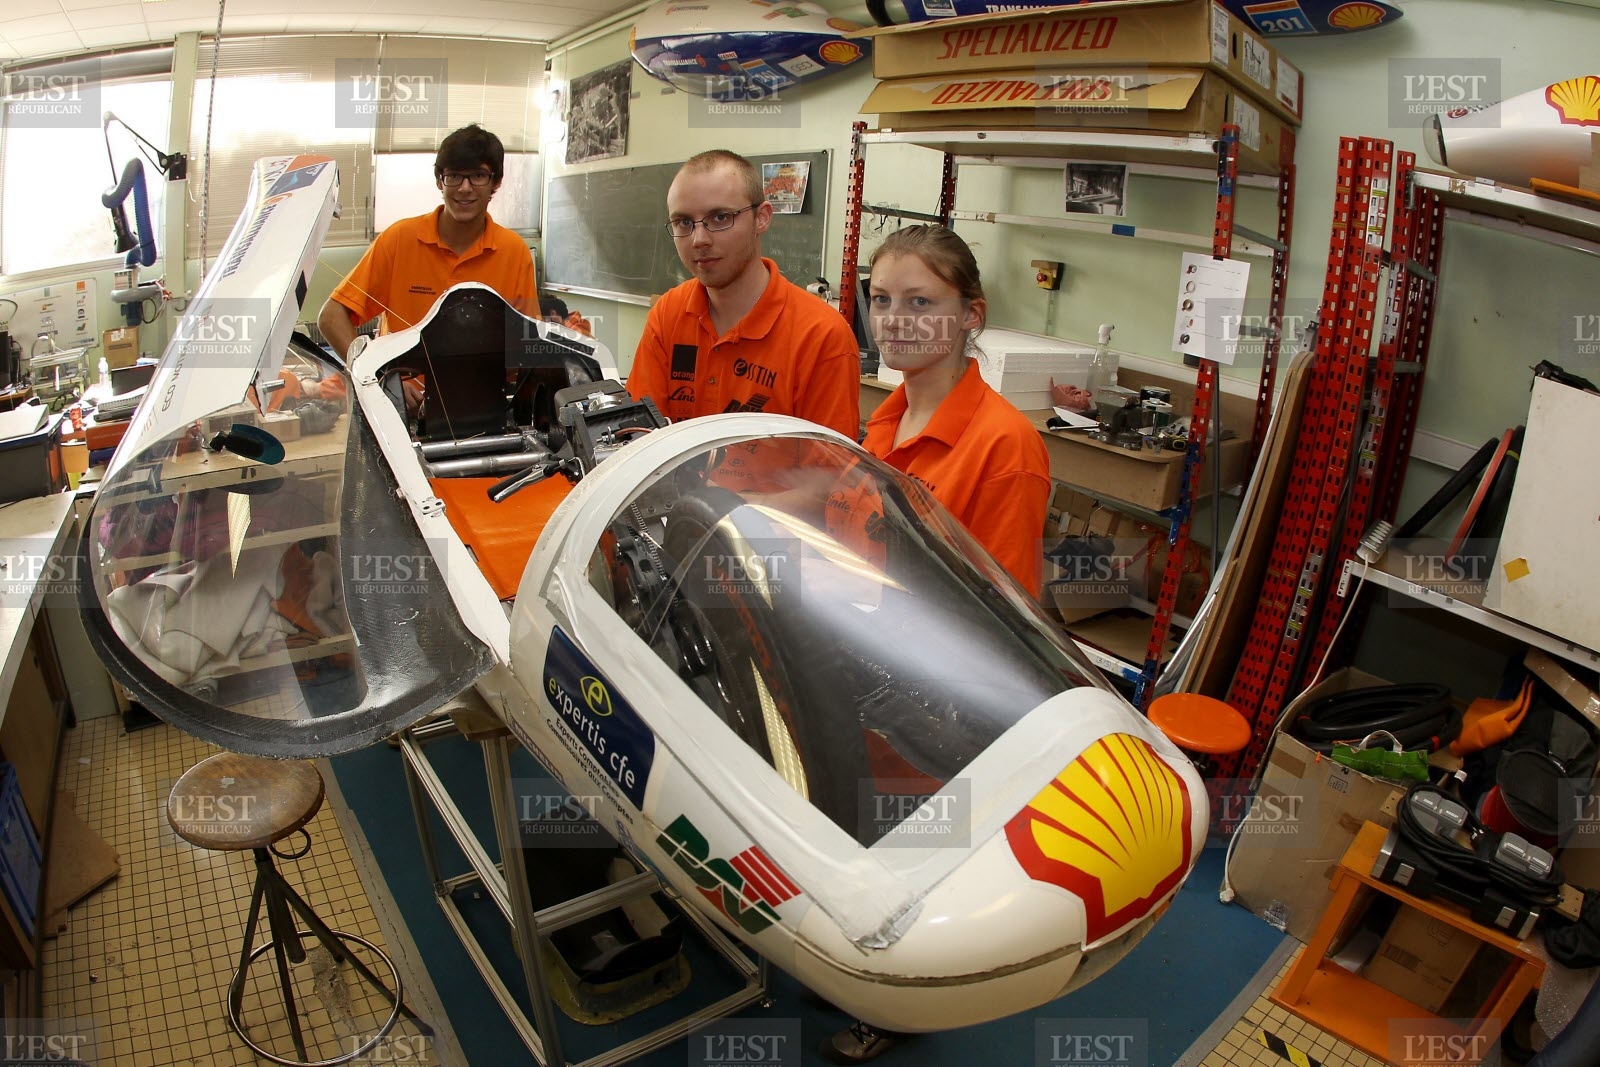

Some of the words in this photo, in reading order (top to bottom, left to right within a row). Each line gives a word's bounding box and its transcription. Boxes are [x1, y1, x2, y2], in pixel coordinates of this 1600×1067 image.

[937, 17, 1118, 60] SPECIALIZED
[1261, 17, 1305, 32] 201
[672, 371, 695, 381] orang
[549, 677, 606, 755] expertis
[610, 751, 635, 789] cfe
[555, 717, 578, 750] Experts
[578, 745, 620, 798] Comptables
[546, 718, 588, 773] Commissaires
[587, 770, 601, 787] aux
[601, 784, 635, 825] Comptes
